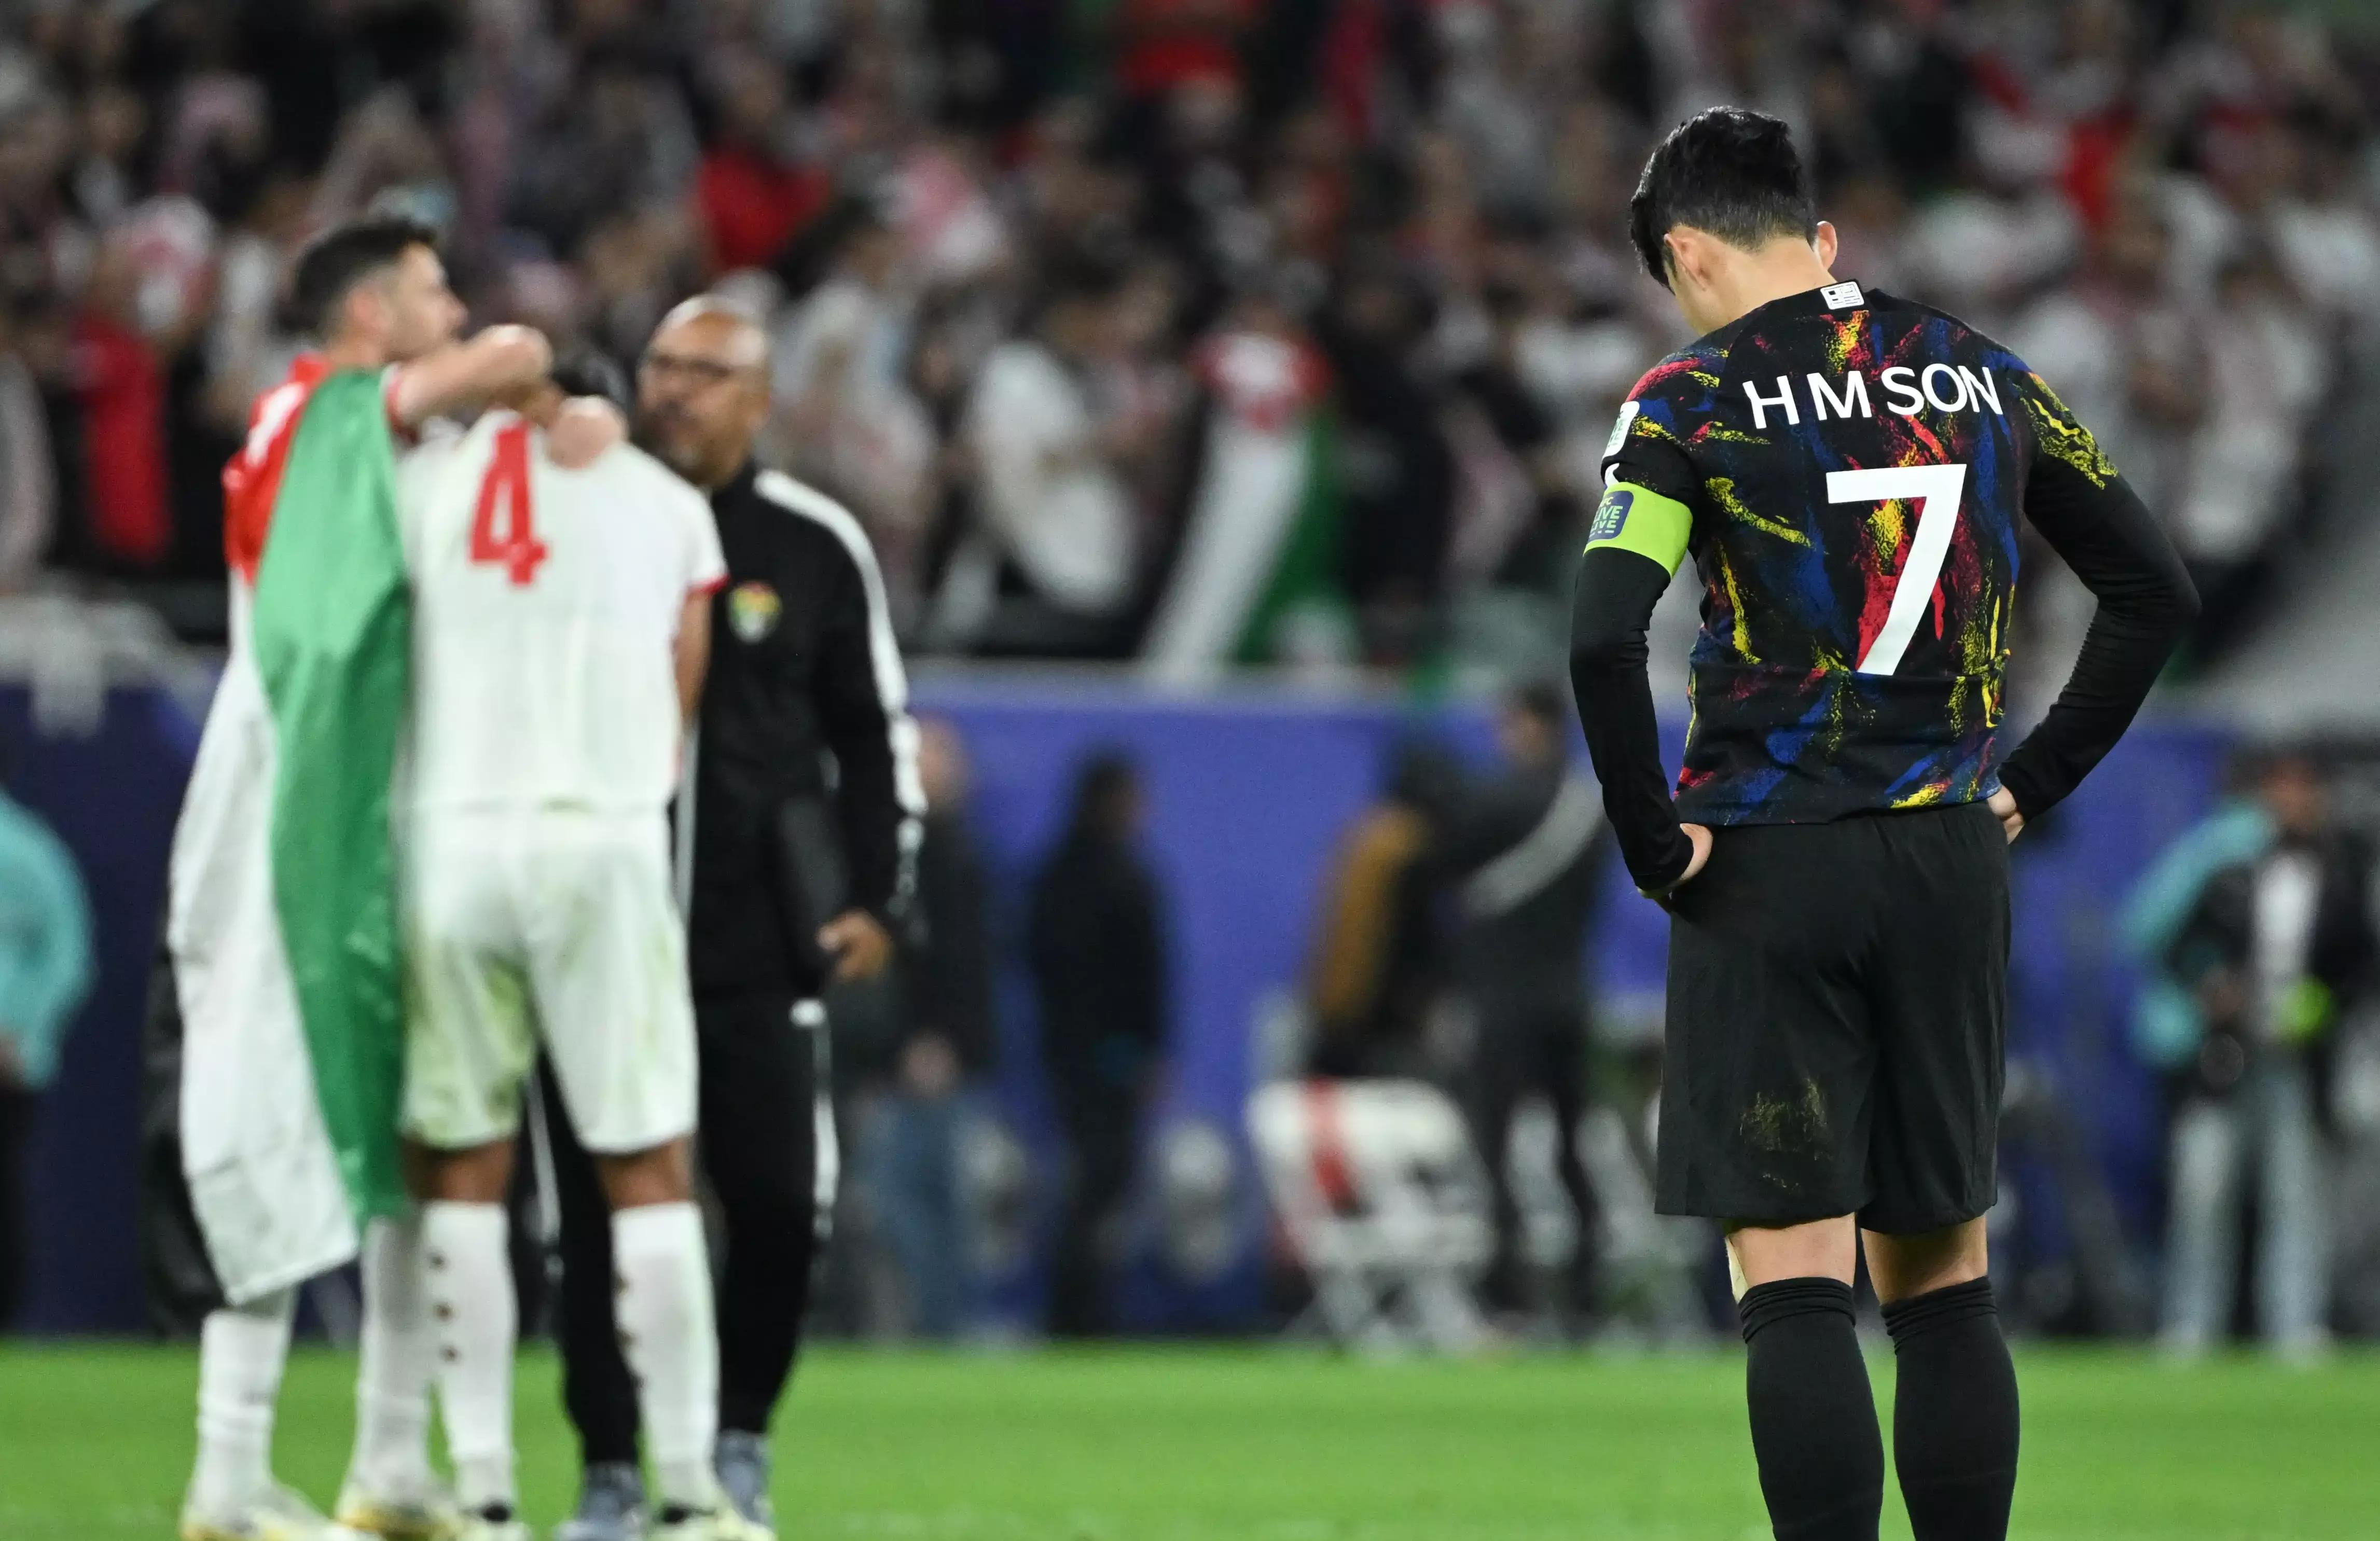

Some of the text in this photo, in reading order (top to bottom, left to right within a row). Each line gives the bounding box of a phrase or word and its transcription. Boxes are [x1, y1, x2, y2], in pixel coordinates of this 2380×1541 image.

[1880, 363, 2003, 417] SON
[469, 419, 548, 586] 4
[1825, 463, 1968, 676] 7
